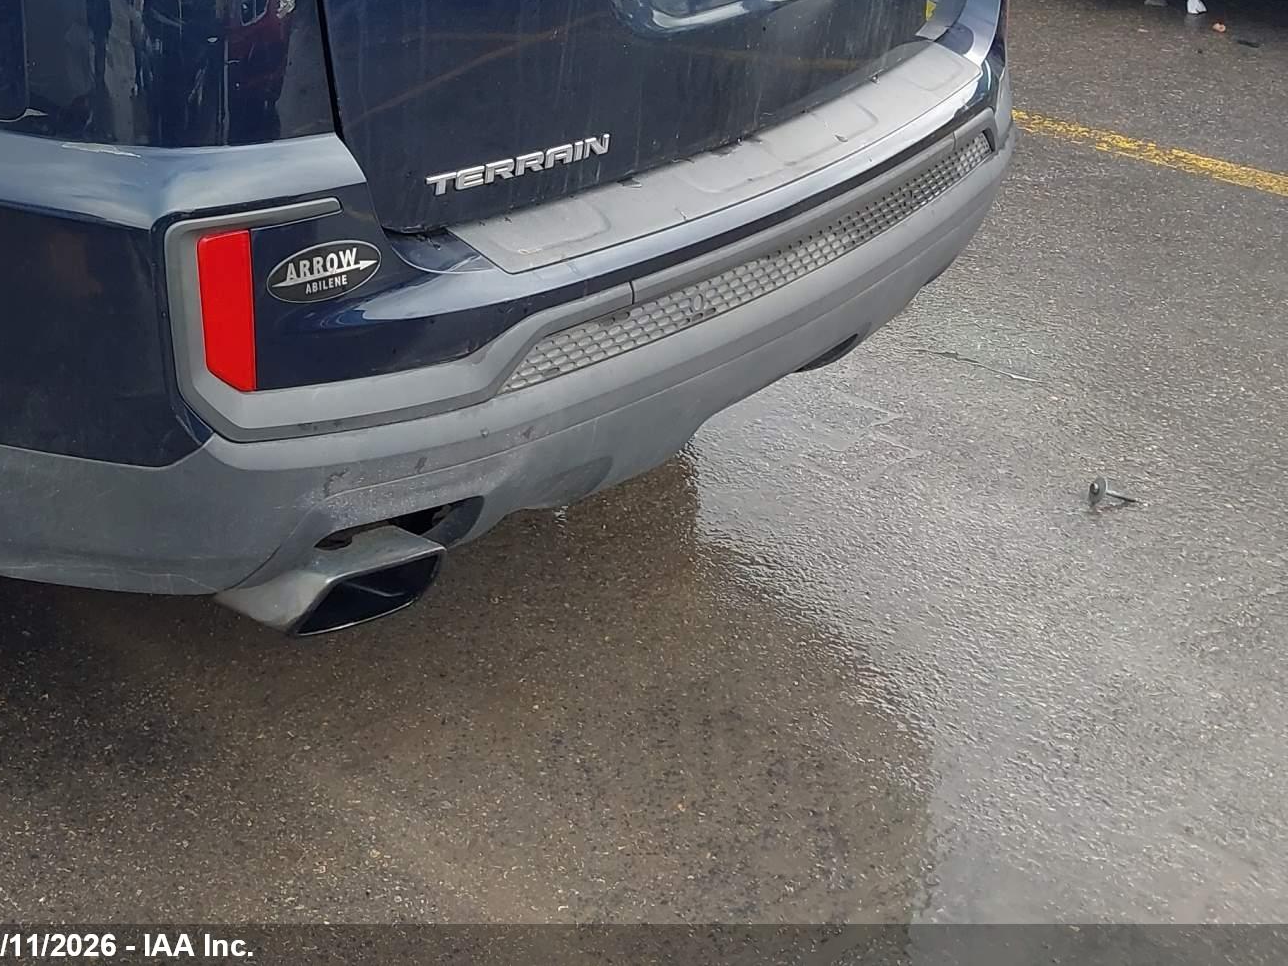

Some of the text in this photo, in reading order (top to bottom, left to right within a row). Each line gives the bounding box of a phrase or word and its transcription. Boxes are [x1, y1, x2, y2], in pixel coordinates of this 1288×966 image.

[425, 133, 611, 196] TERRAIN
[285, 247, 359, 282] ARROW
[305, 275, 348, 295] ABILENE
